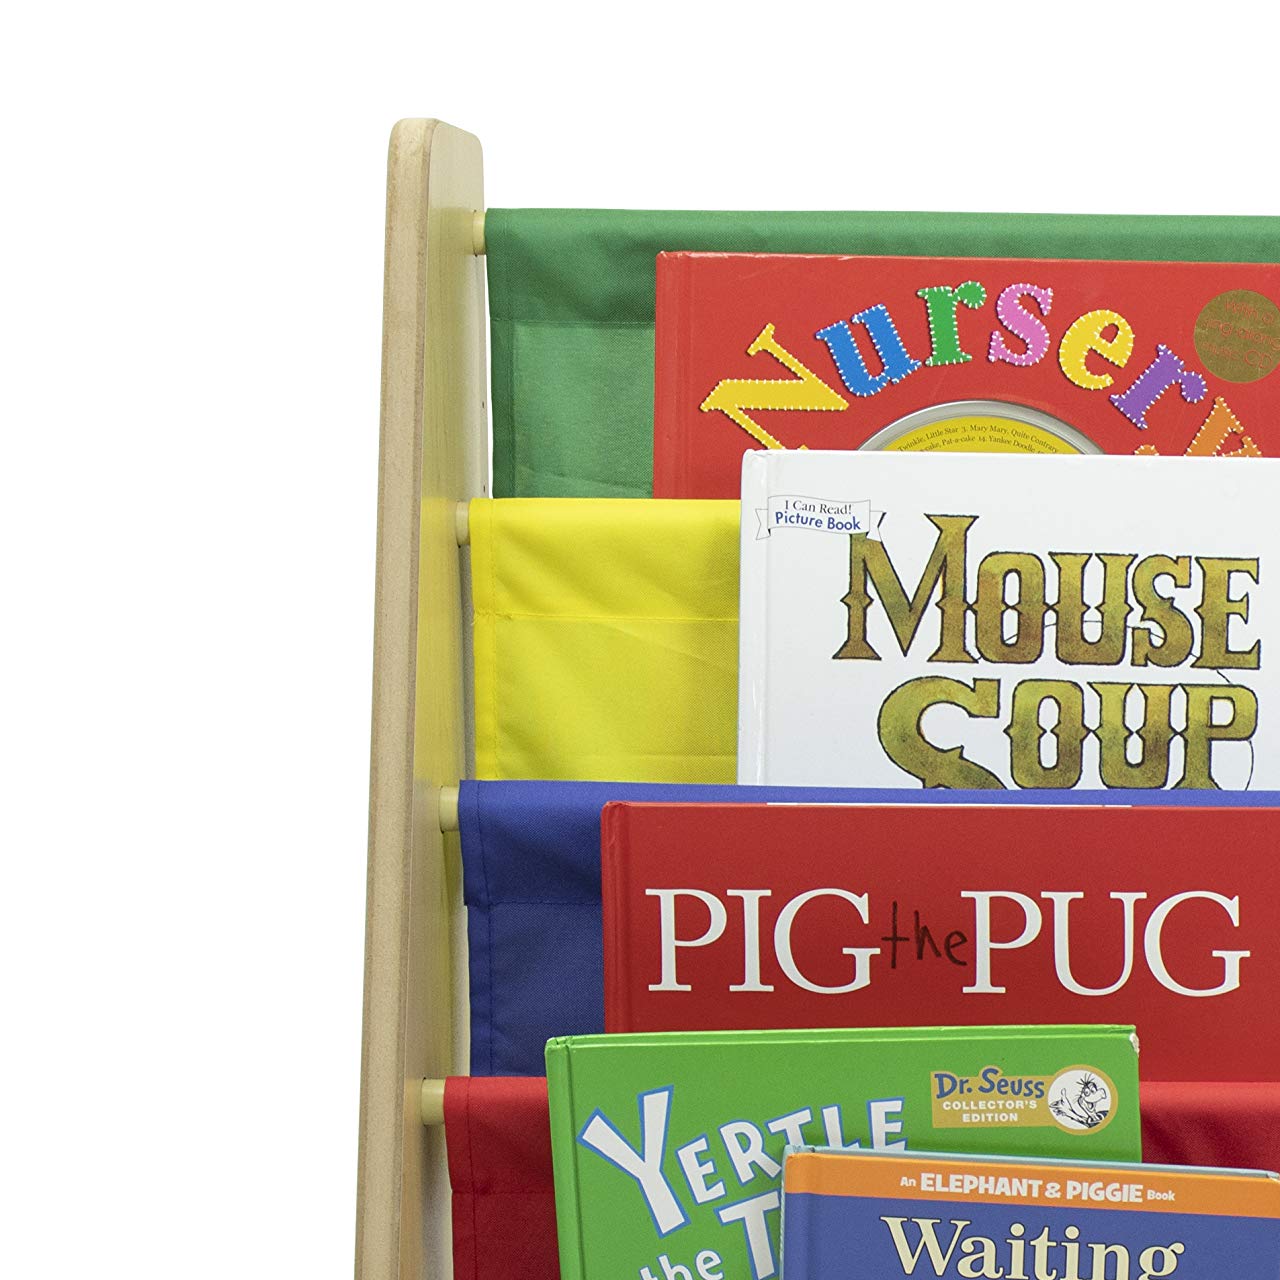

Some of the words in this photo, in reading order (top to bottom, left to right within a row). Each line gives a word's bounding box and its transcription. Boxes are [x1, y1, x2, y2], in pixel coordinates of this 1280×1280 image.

[925, 430, 944, 440] Little
[944, 426, 958, 435] Star
[970, 424, 988, 433] Mary
[1011, 428, 1030, 440] Quite
[989, 435, 1012, 445] Yankee
[792, 500, 816, 513] Can
[819, 503, 852, 515] Read!
[775, 511, 823, 528] Picture
[827, 516, 861, 531] Book
[645, 887, 881, 995] PIG
[880, 900, 969, 969] the
[960, 890, 1250, 998] PUG
[933, 1072, 973, 1100] Dr.
[978, 1067, 1045, 1099] Seuss
[942, 1100, 1038, 1111] COLLECTOR'S
[962, 1112, 1018, 1123] EDITION
[576, 1083, 907, 1240] YERTLE
[900, 1176, 916, 1188] An
[920, 1172, 1043, 1198] ELEPHANT
[1044, 1182, 1061, 1199] &
[1066, 1180, 1144, 1203] PIGGIE
[1147, 1189, 1176, 1202] Book
